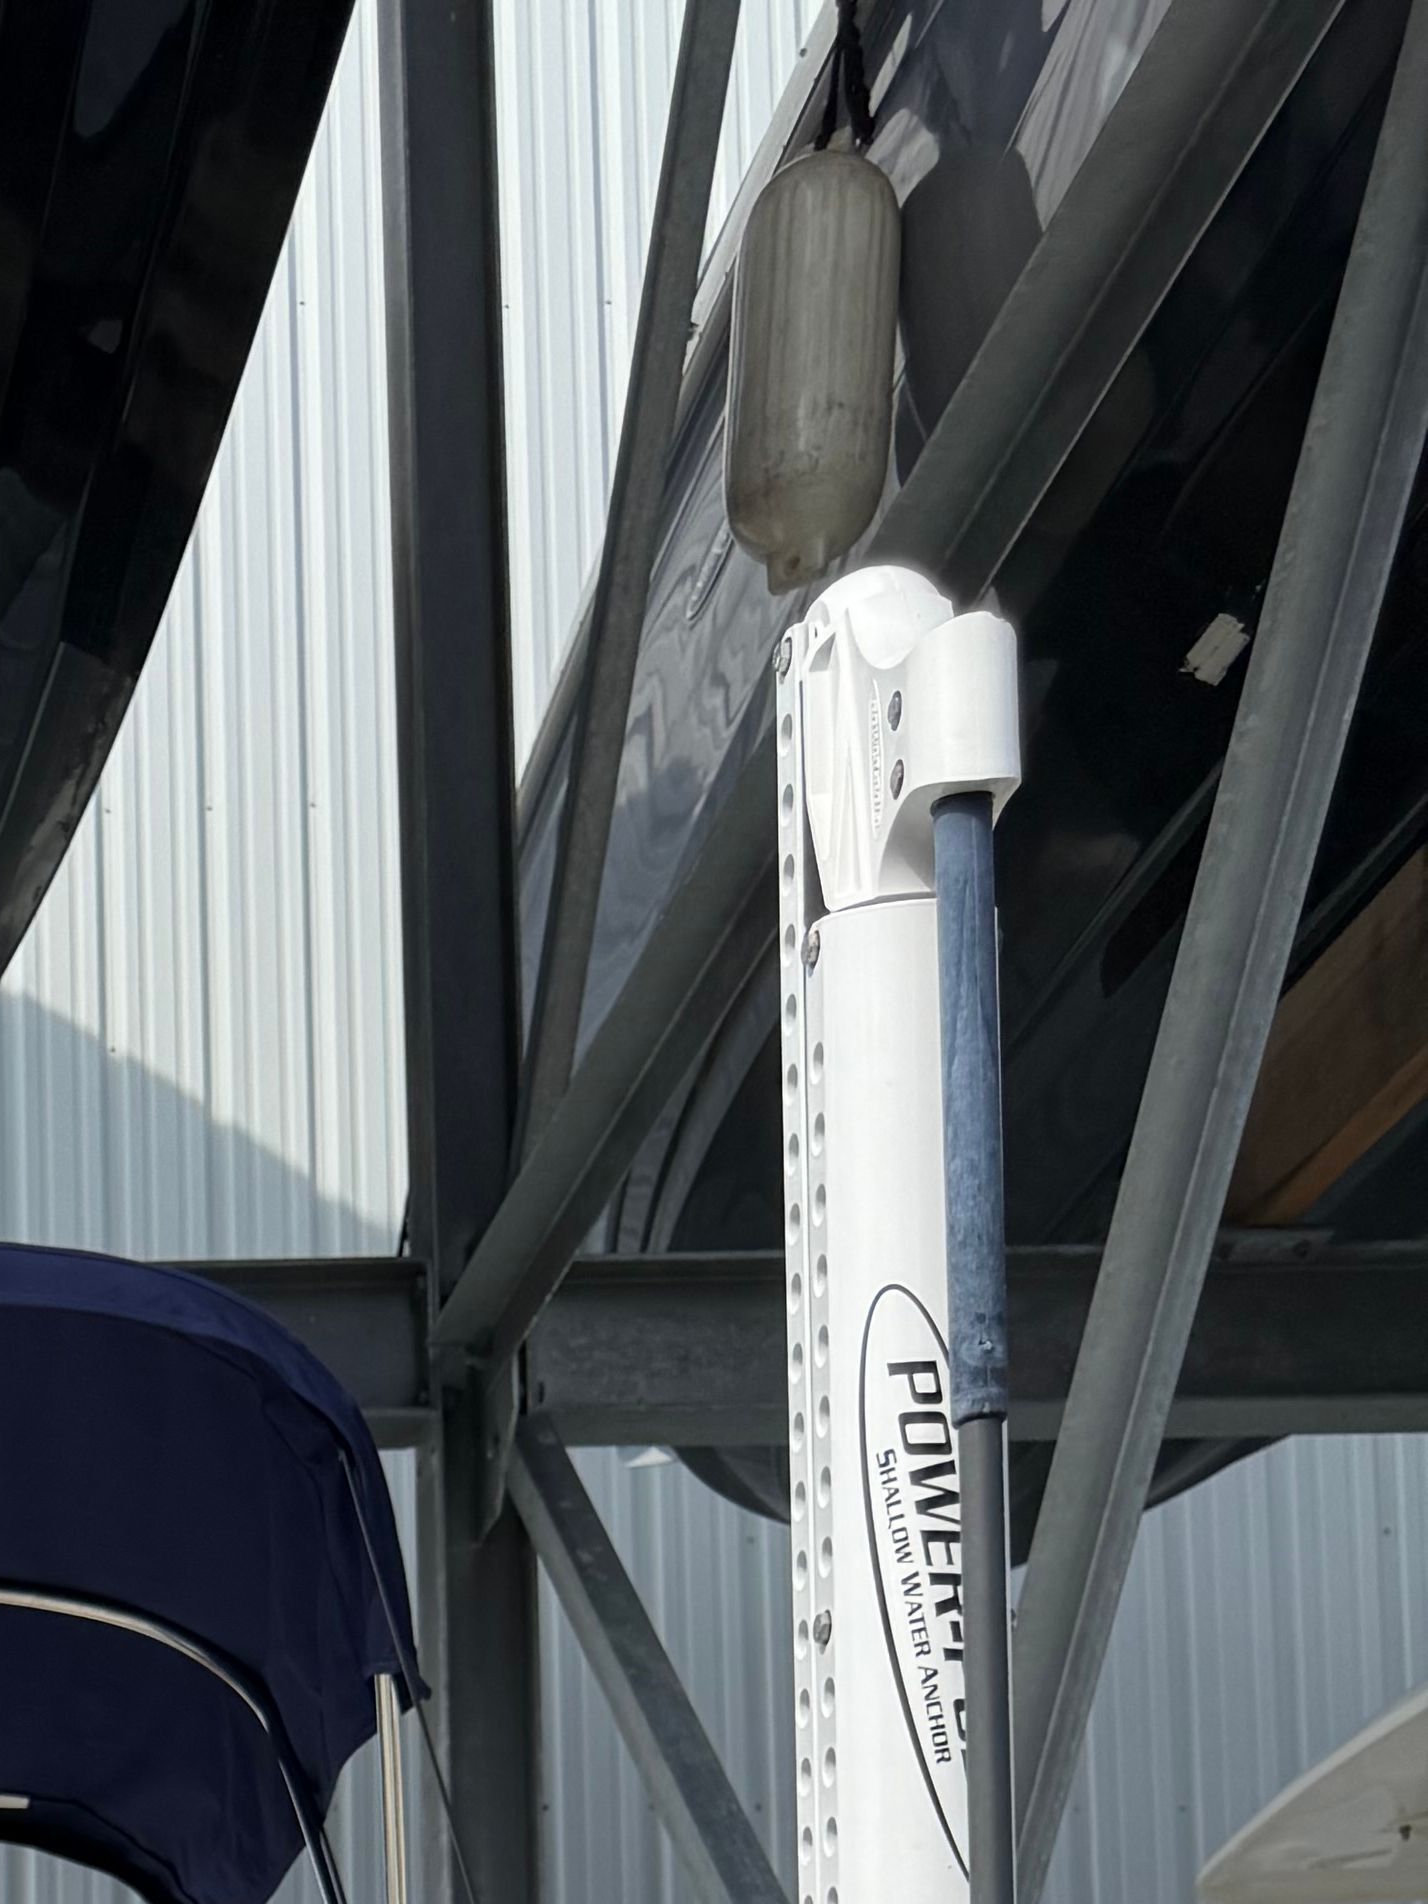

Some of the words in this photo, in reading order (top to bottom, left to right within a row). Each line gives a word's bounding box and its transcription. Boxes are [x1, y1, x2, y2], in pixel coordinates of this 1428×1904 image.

[876, 1448, 914, 1564] SHALLOW
[901, 1571, 932, 1658] WATER
[917, 1665, 952, 1764] ANCHOR
